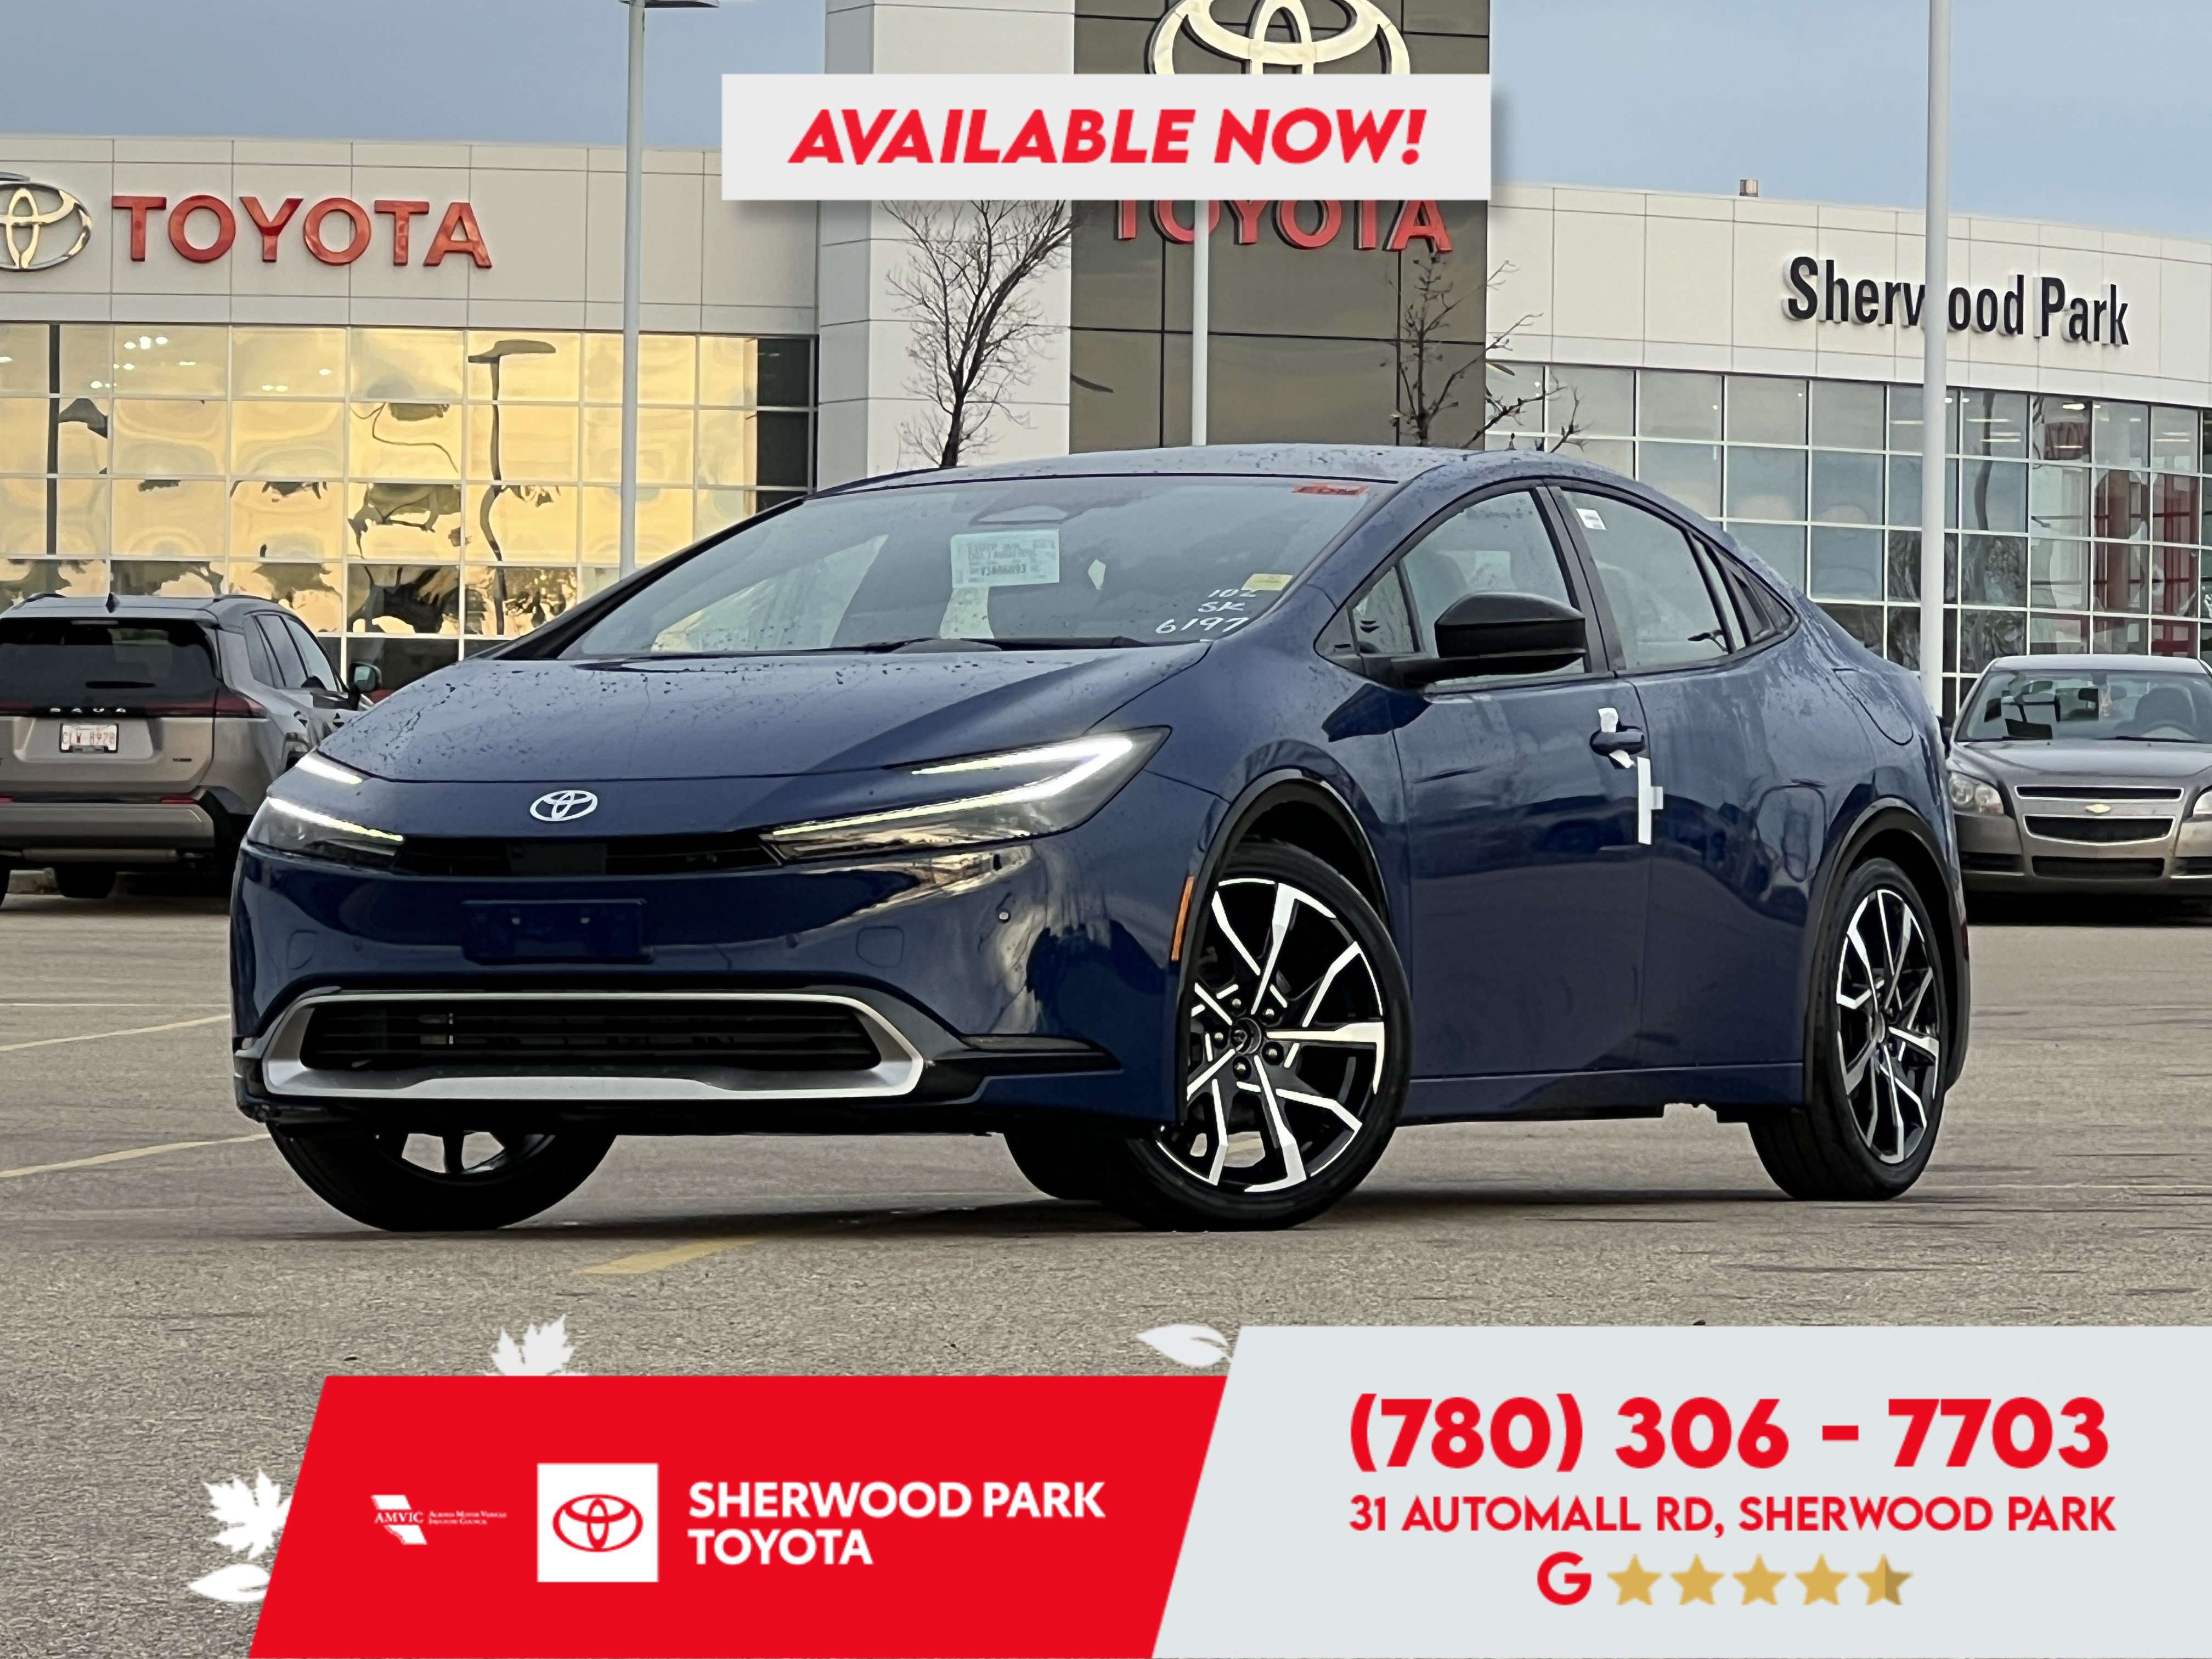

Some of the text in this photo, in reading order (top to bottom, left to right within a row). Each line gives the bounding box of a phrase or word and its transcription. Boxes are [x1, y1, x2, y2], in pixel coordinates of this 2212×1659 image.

[112, 194, 492, 269] TOYOTA
[2039, 276, 2129, 346] Park
[1155, 617, 1250, 634] 6197
